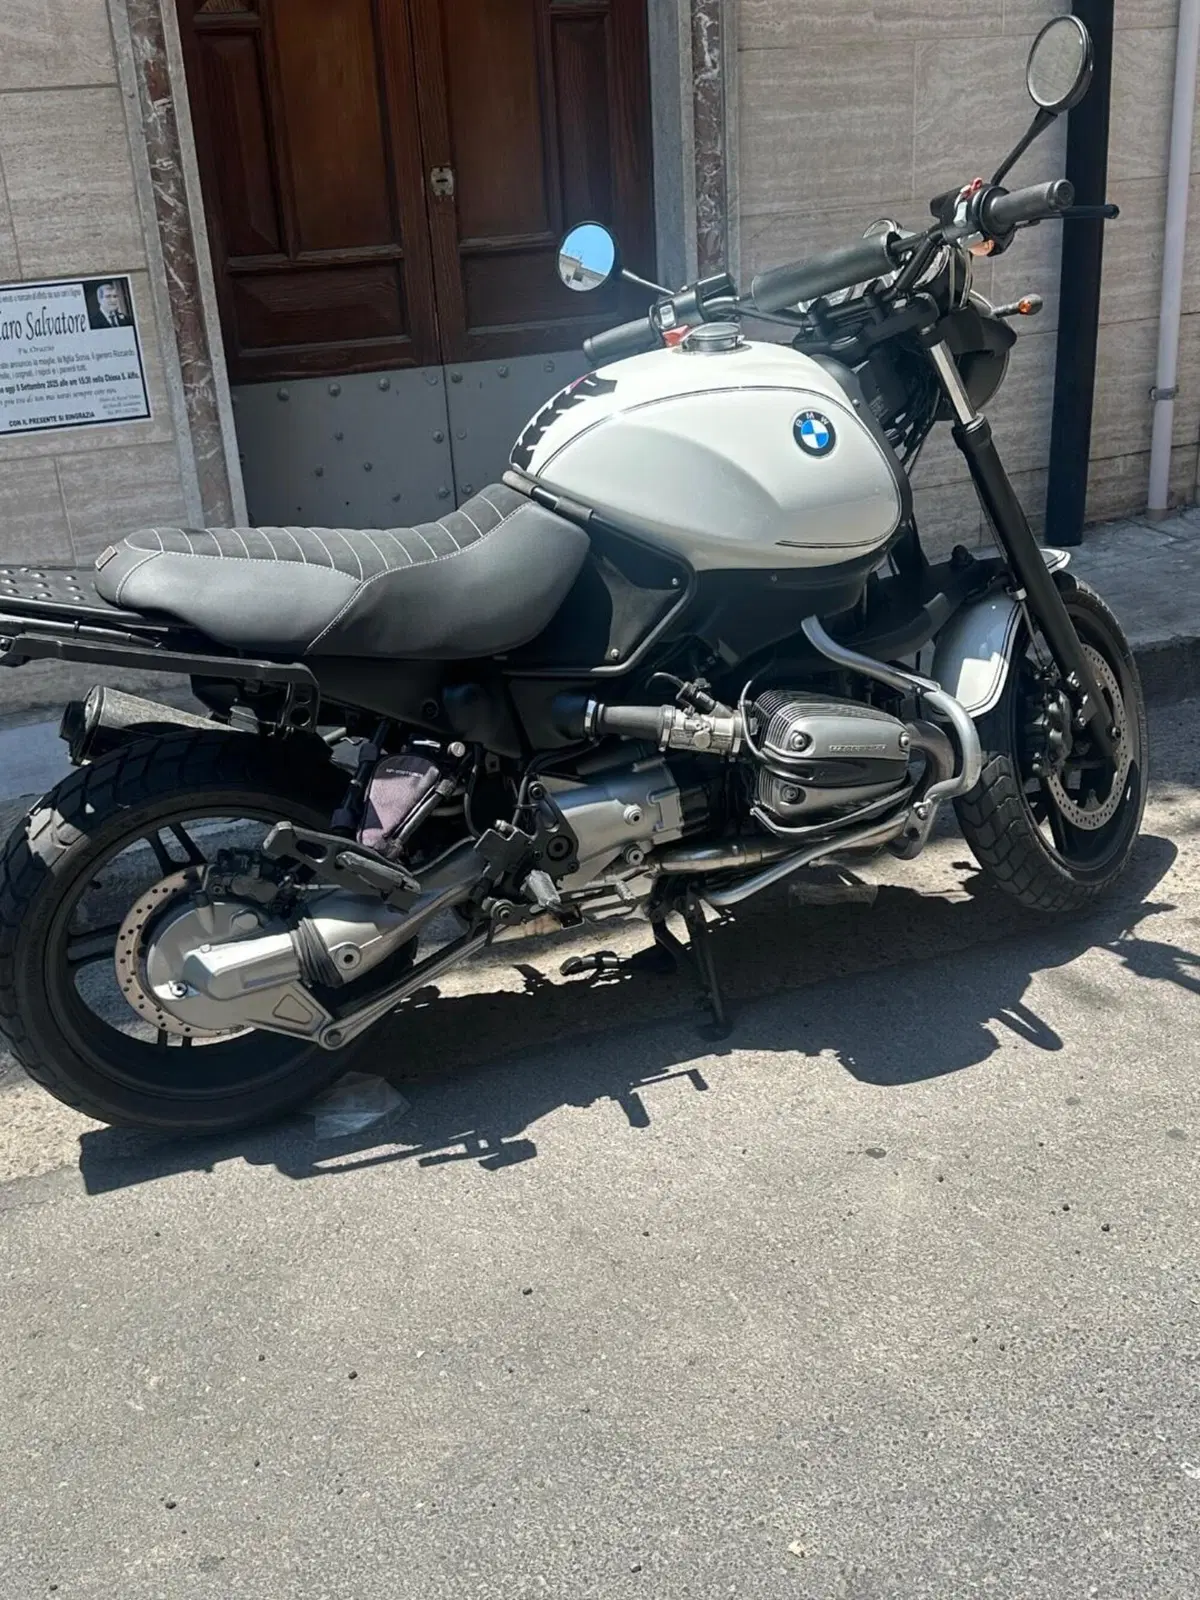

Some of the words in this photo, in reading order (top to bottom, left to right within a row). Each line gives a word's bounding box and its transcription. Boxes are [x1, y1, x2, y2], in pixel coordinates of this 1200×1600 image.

[26, 306, 87, 340] Salvatore
[8, 419, 21, 427] CON
[28, 415, 57, 425] PRESENTE
[65, 411, 95, 421] RINGRAZIA
[795, 411, 830, 428] BMW
